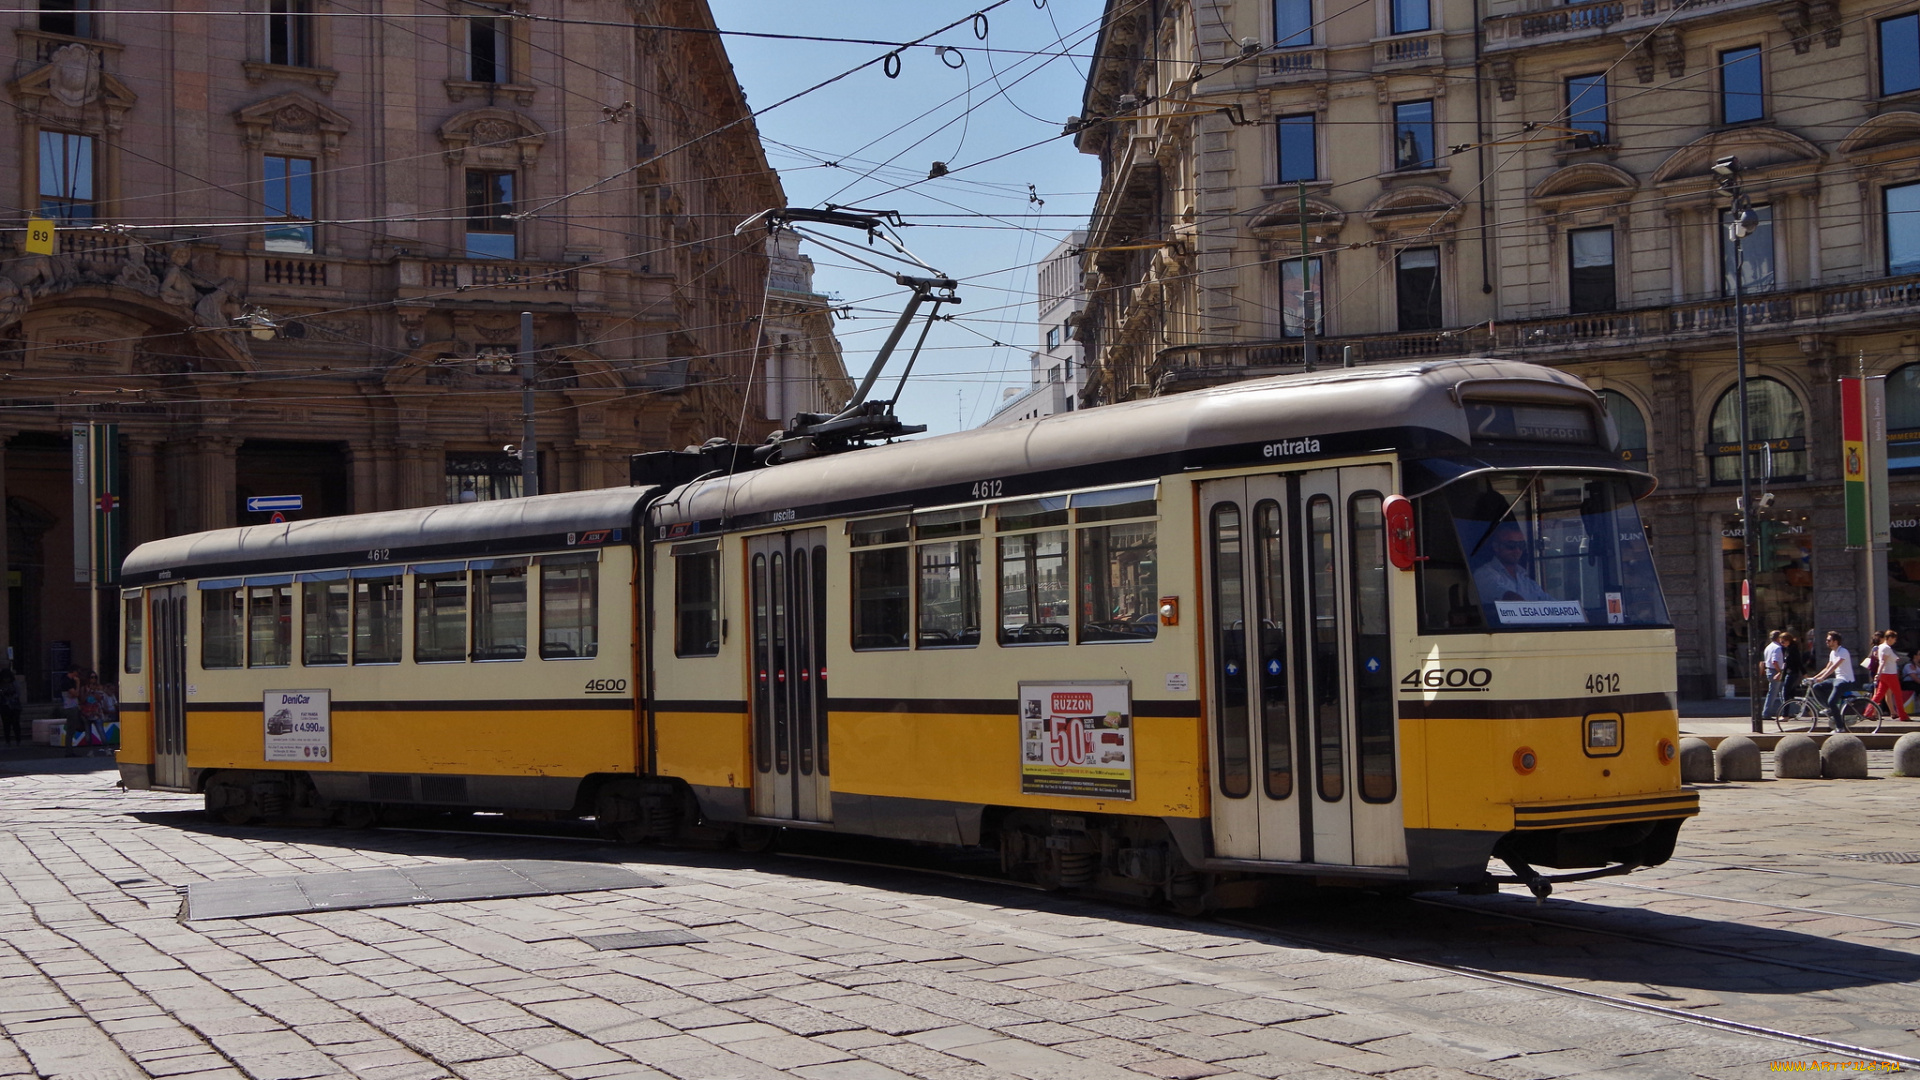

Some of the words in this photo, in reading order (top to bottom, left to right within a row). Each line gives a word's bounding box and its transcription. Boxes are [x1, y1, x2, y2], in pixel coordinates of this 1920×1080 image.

[33, 230, 48, 242] 89
[55, 338, 107, 354] POSTE
[1474, 404, 1499, 435] 2
[1263, 438, 1320, 457] entrata
[972, 480, 1002, 499] 4612
[773, 508, 795, 522] uscita
[1889, 518, 1917, 528] ARLO
[368, 548, 390, 562] 4612
[1519, 607, 1538, 617] LEGA
[1539, 607, 1580, 617] LOMBARDA
[1400, 667, 1492, 687] 4600
[1585, 673, 1620, 694] 4612
[585, 679, 626, 692] 4600
[282, 694, 311, 704] DeniCar
[1053, 699, 1092, 711] RUZZON
